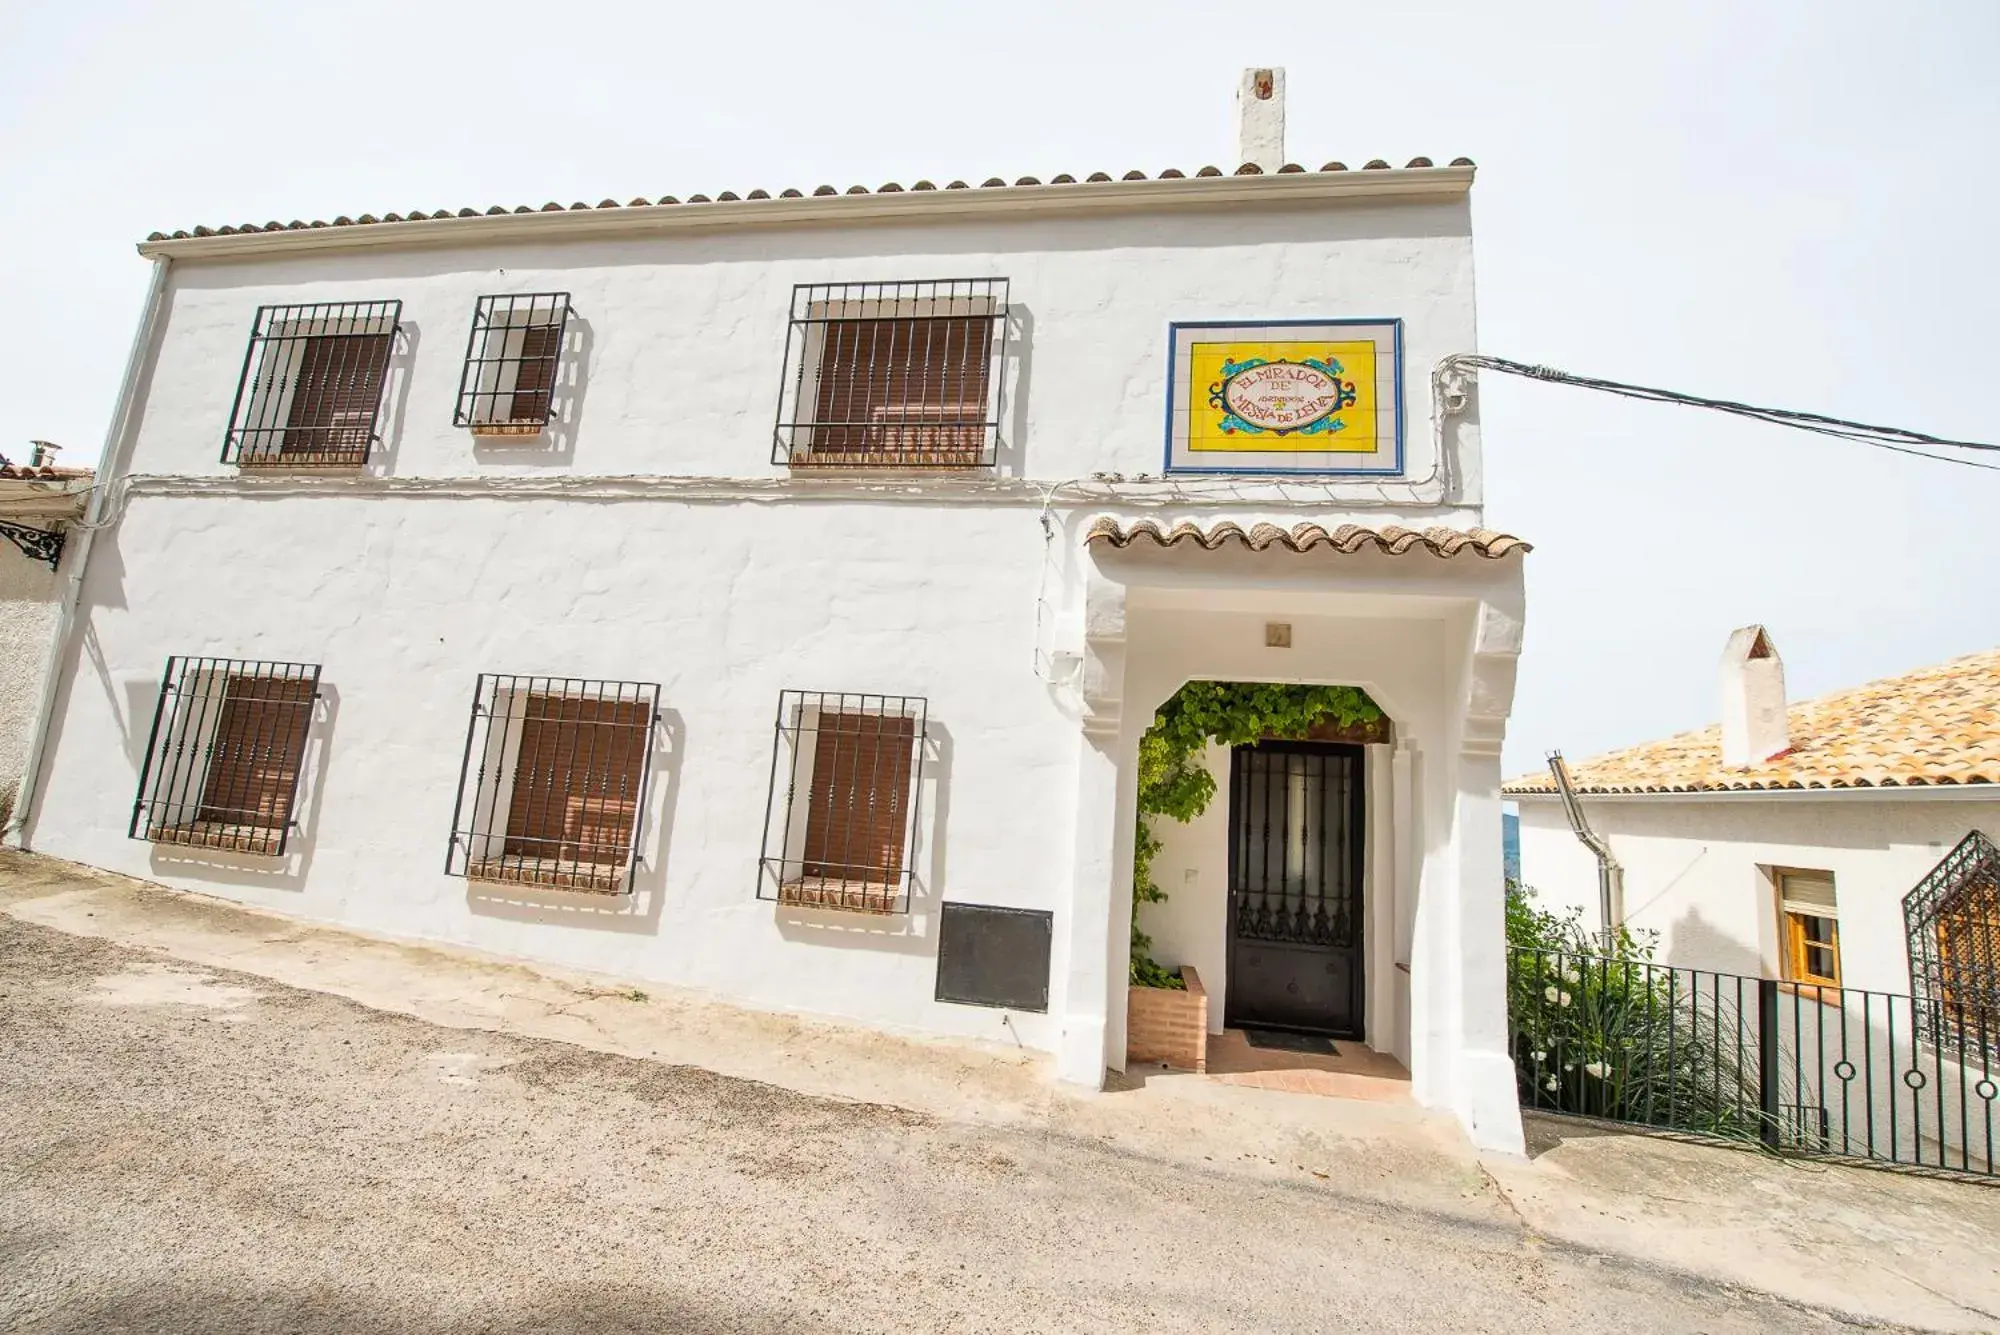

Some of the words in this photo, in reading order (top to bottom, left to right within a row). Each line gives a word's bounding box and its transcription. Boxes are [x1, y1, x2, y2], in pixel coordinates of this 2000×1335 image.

[1236, 376, 1255, 390] EL
[1255, 366, 1328, 390] MIRADOR
[1271, 381, 1290, 390] DE
[1277, 413, 1293, 423] DE
